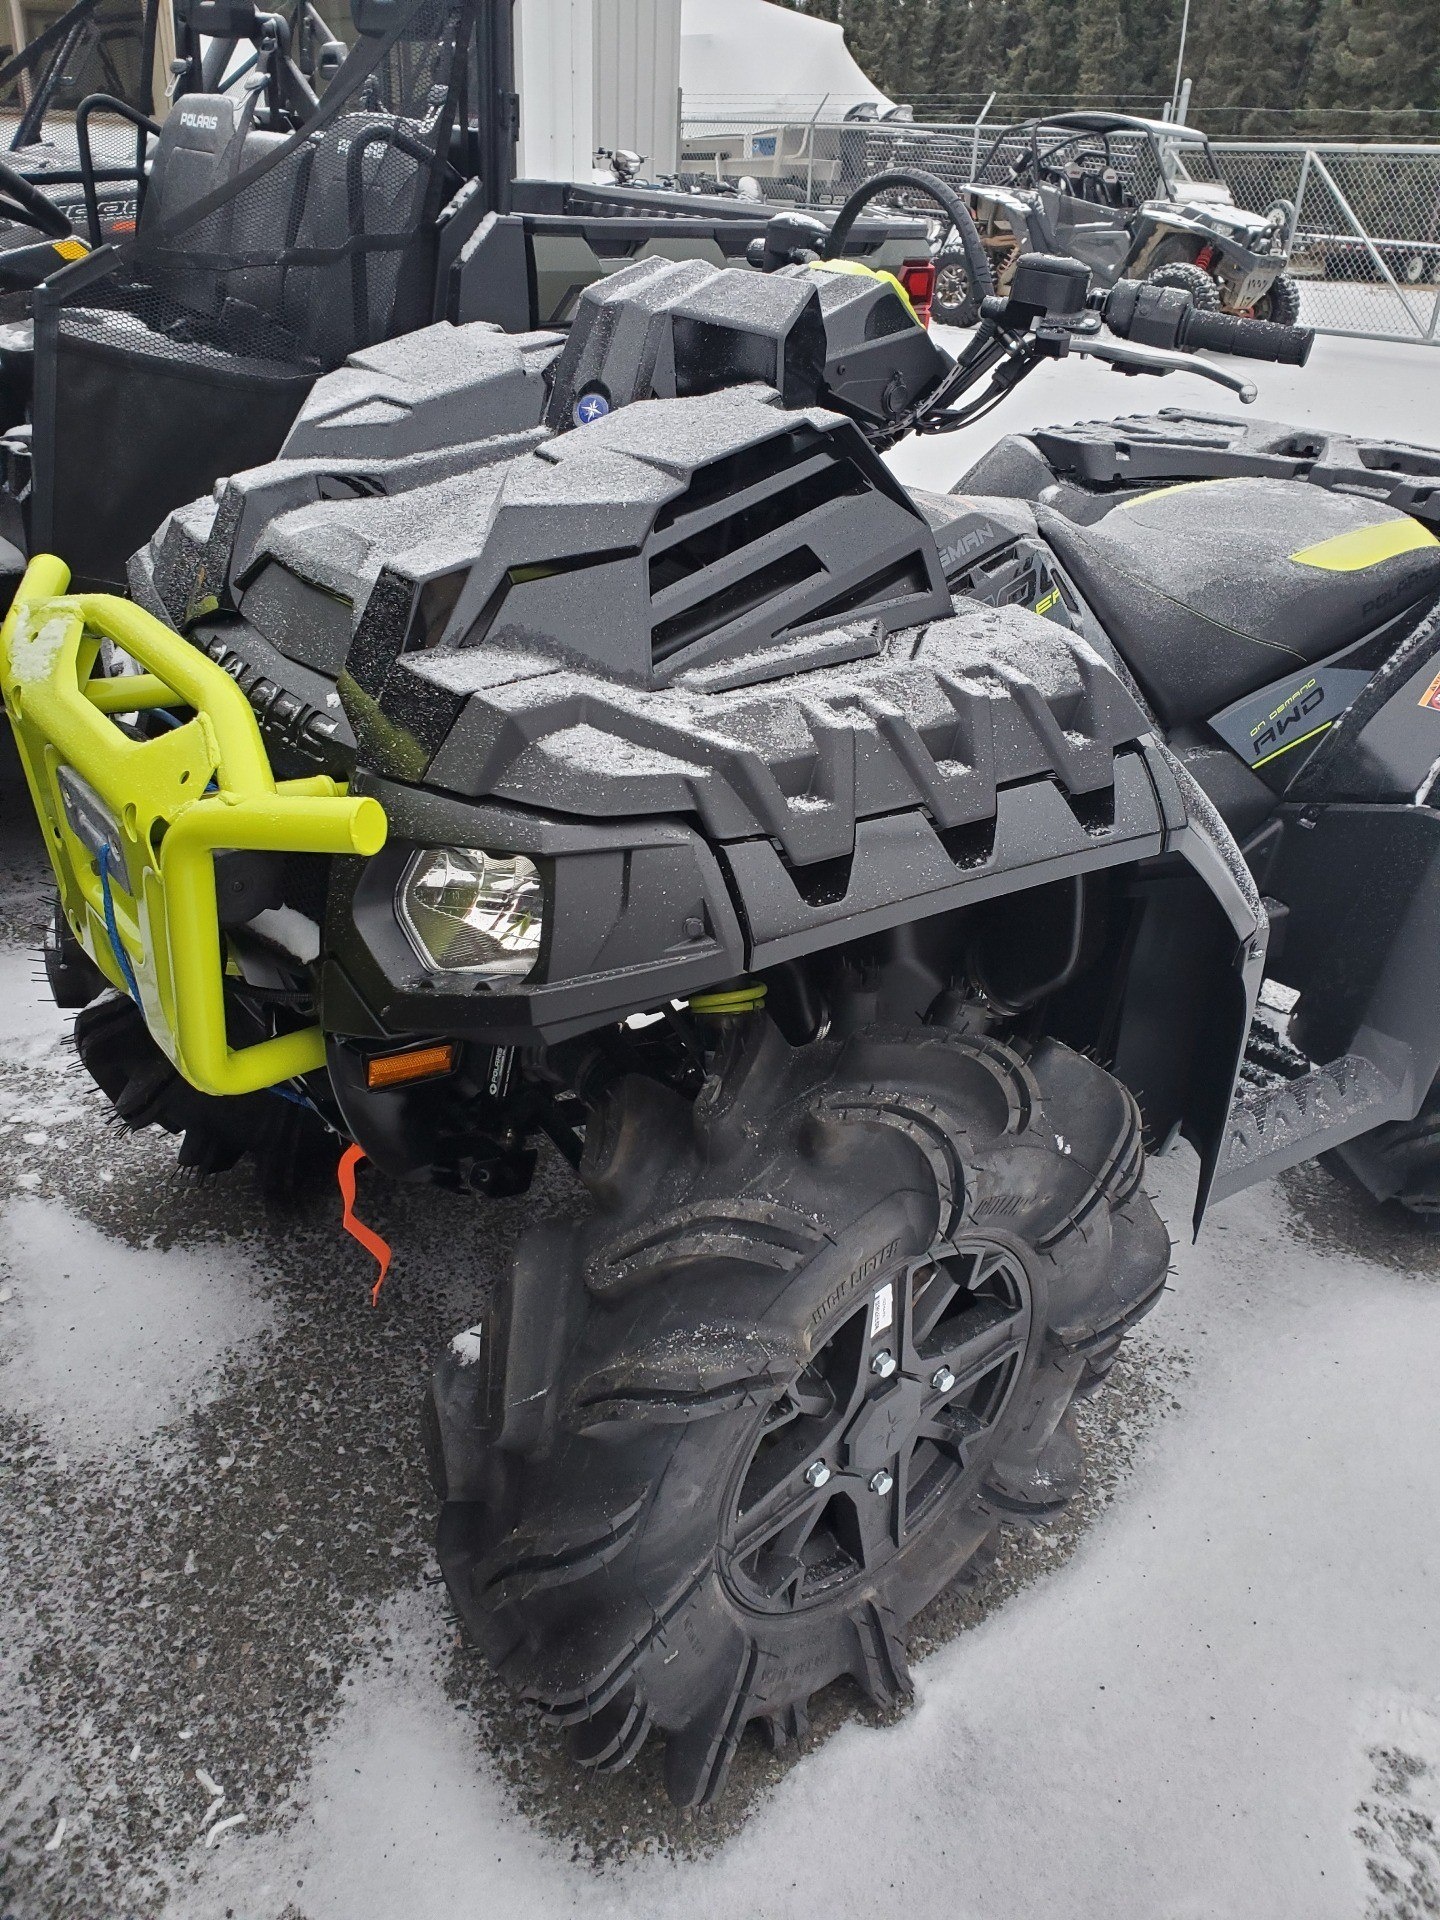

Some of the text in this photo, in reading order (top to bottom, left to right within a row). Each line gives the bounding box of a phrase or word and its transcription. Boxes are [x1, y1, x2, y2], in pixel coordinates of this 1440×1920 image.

[180, 112, 218, 130] POLARIS
[1269, 678, 1316, 720] DEMAND
[1252, 686, 1325, 756] AWD
[491, 1047, 504, 1083] POLARIS
